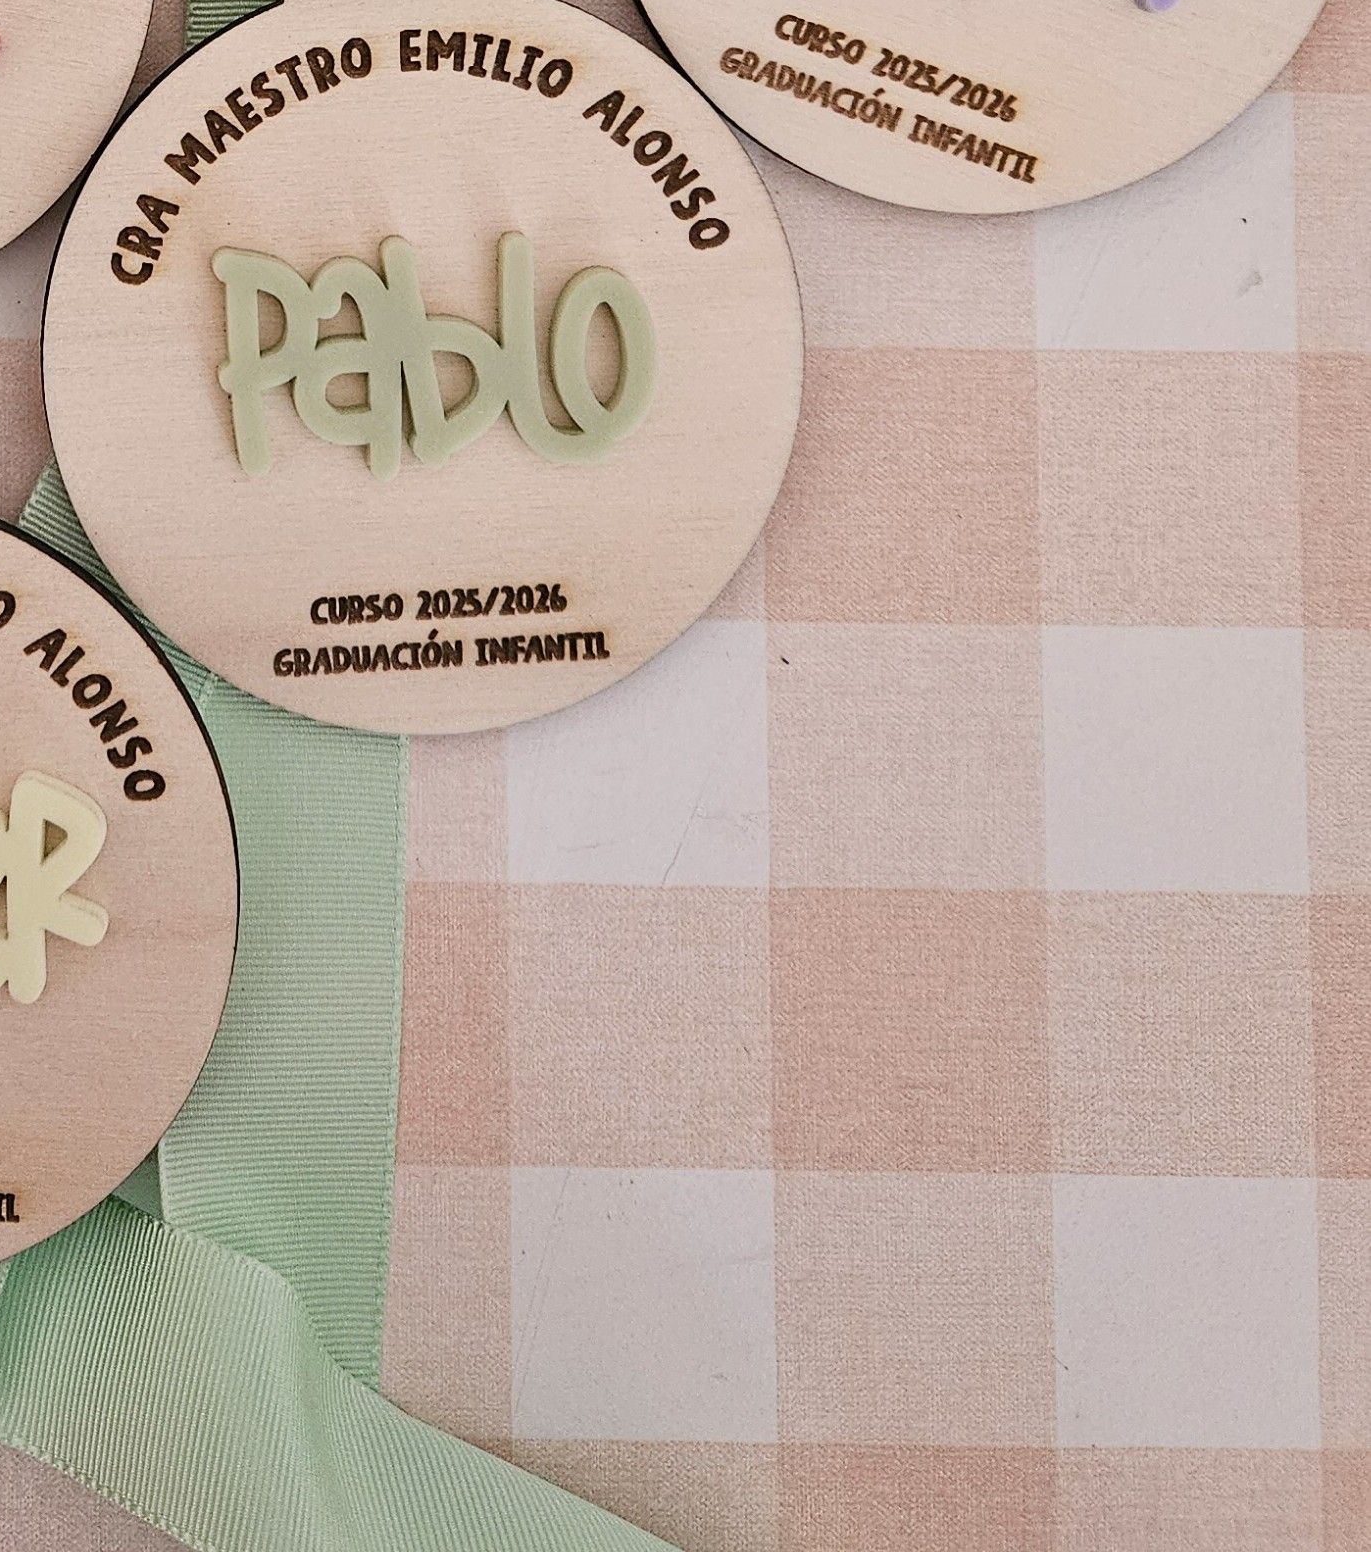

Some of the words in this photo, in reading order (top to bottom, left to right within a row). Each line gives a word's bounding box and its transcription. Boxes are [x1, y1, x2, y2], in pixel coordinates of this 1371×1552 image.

[720, 47, 903, 132] GRADUACIÓN
[908, 114, 1038, 183] INFANTIL
[775, 15, 867, 65] CURSO
[871, 48, 1017, 122] 2025/2026
[111, 194, 180, 285] CRA
[164, 38, 372, 185] MAESTRO
[400, 29, 573, 98] EMILIO
[582, 90, 730, 250] ALONSO
[273, 628, 463, 677] GRADUACIÓN
[474, 631, 610, 667] INFANTIL
[310, 593, 403, 625] CURSO
[416, 583, 567, 620] 2025/2026
[23, 628, 166, 801] ALONSO
